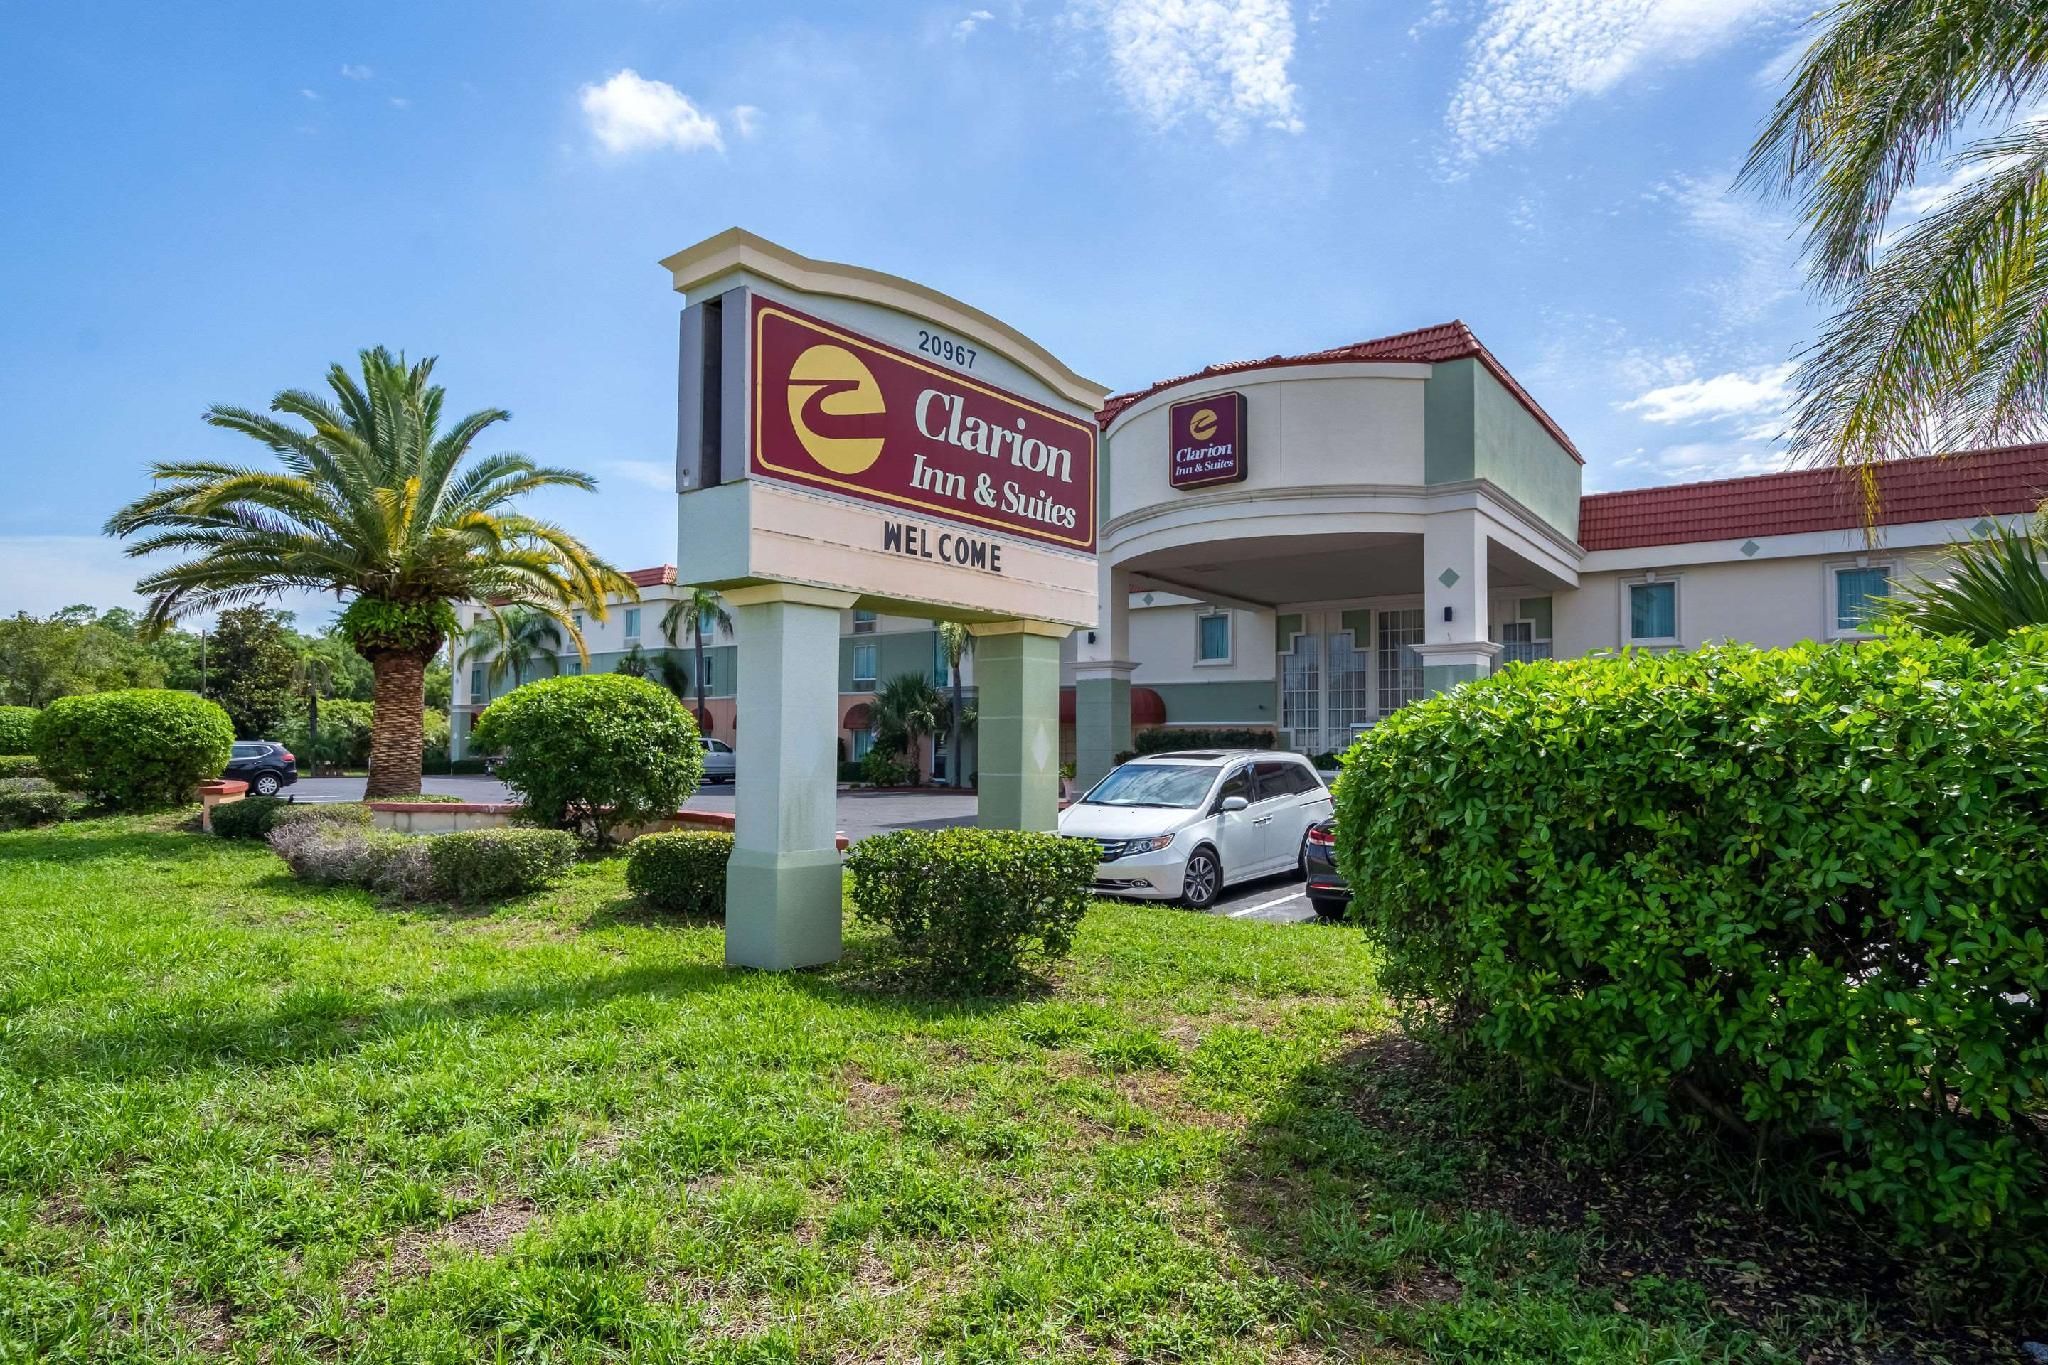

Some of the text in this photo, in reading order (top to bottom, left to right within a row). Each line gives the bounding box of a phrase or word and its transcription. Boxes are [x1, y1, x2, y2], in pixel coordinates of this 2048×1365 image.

[918, 330, 977, 370] 20967
[915, 388, 1073, 483] Clarion
[1176, 443, 1233, 462] Clarion
[1175, 458, 1234, 476] Inn & Suites
[909, 453, 1076, 529] Inn & Suites
[884, 520, 1002, 572] WELCOME
